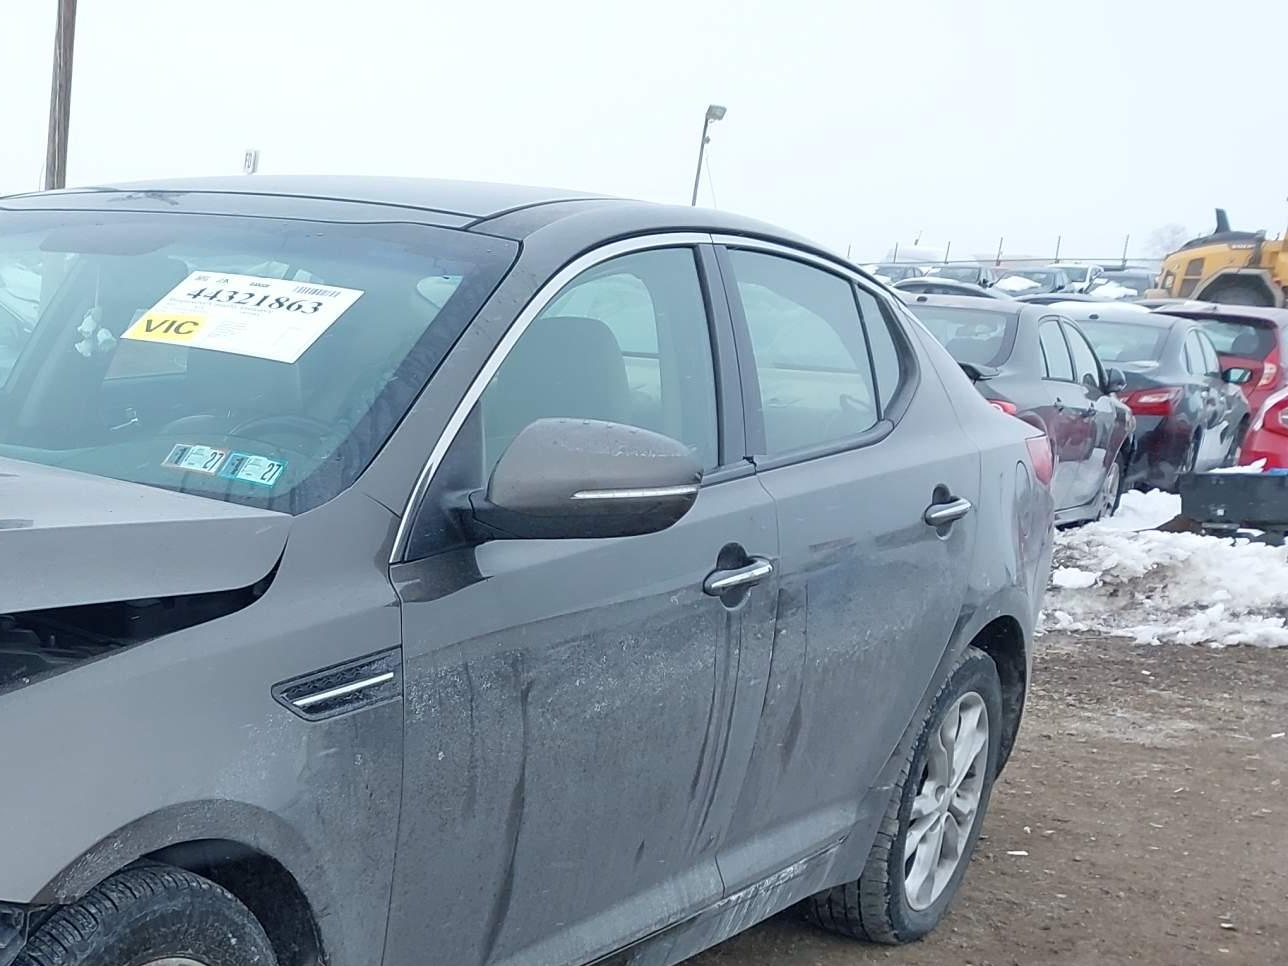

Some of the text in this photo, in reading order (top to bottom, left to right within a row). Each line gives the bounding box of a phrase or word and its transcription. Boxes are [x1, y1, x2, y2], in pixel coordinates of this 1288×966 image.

[187, 287, 324, 315] 44321863
[144, 318, 199, 336] VIC
[203, 451, 225, 472] 27
[261, 462, 282, 482] 27
